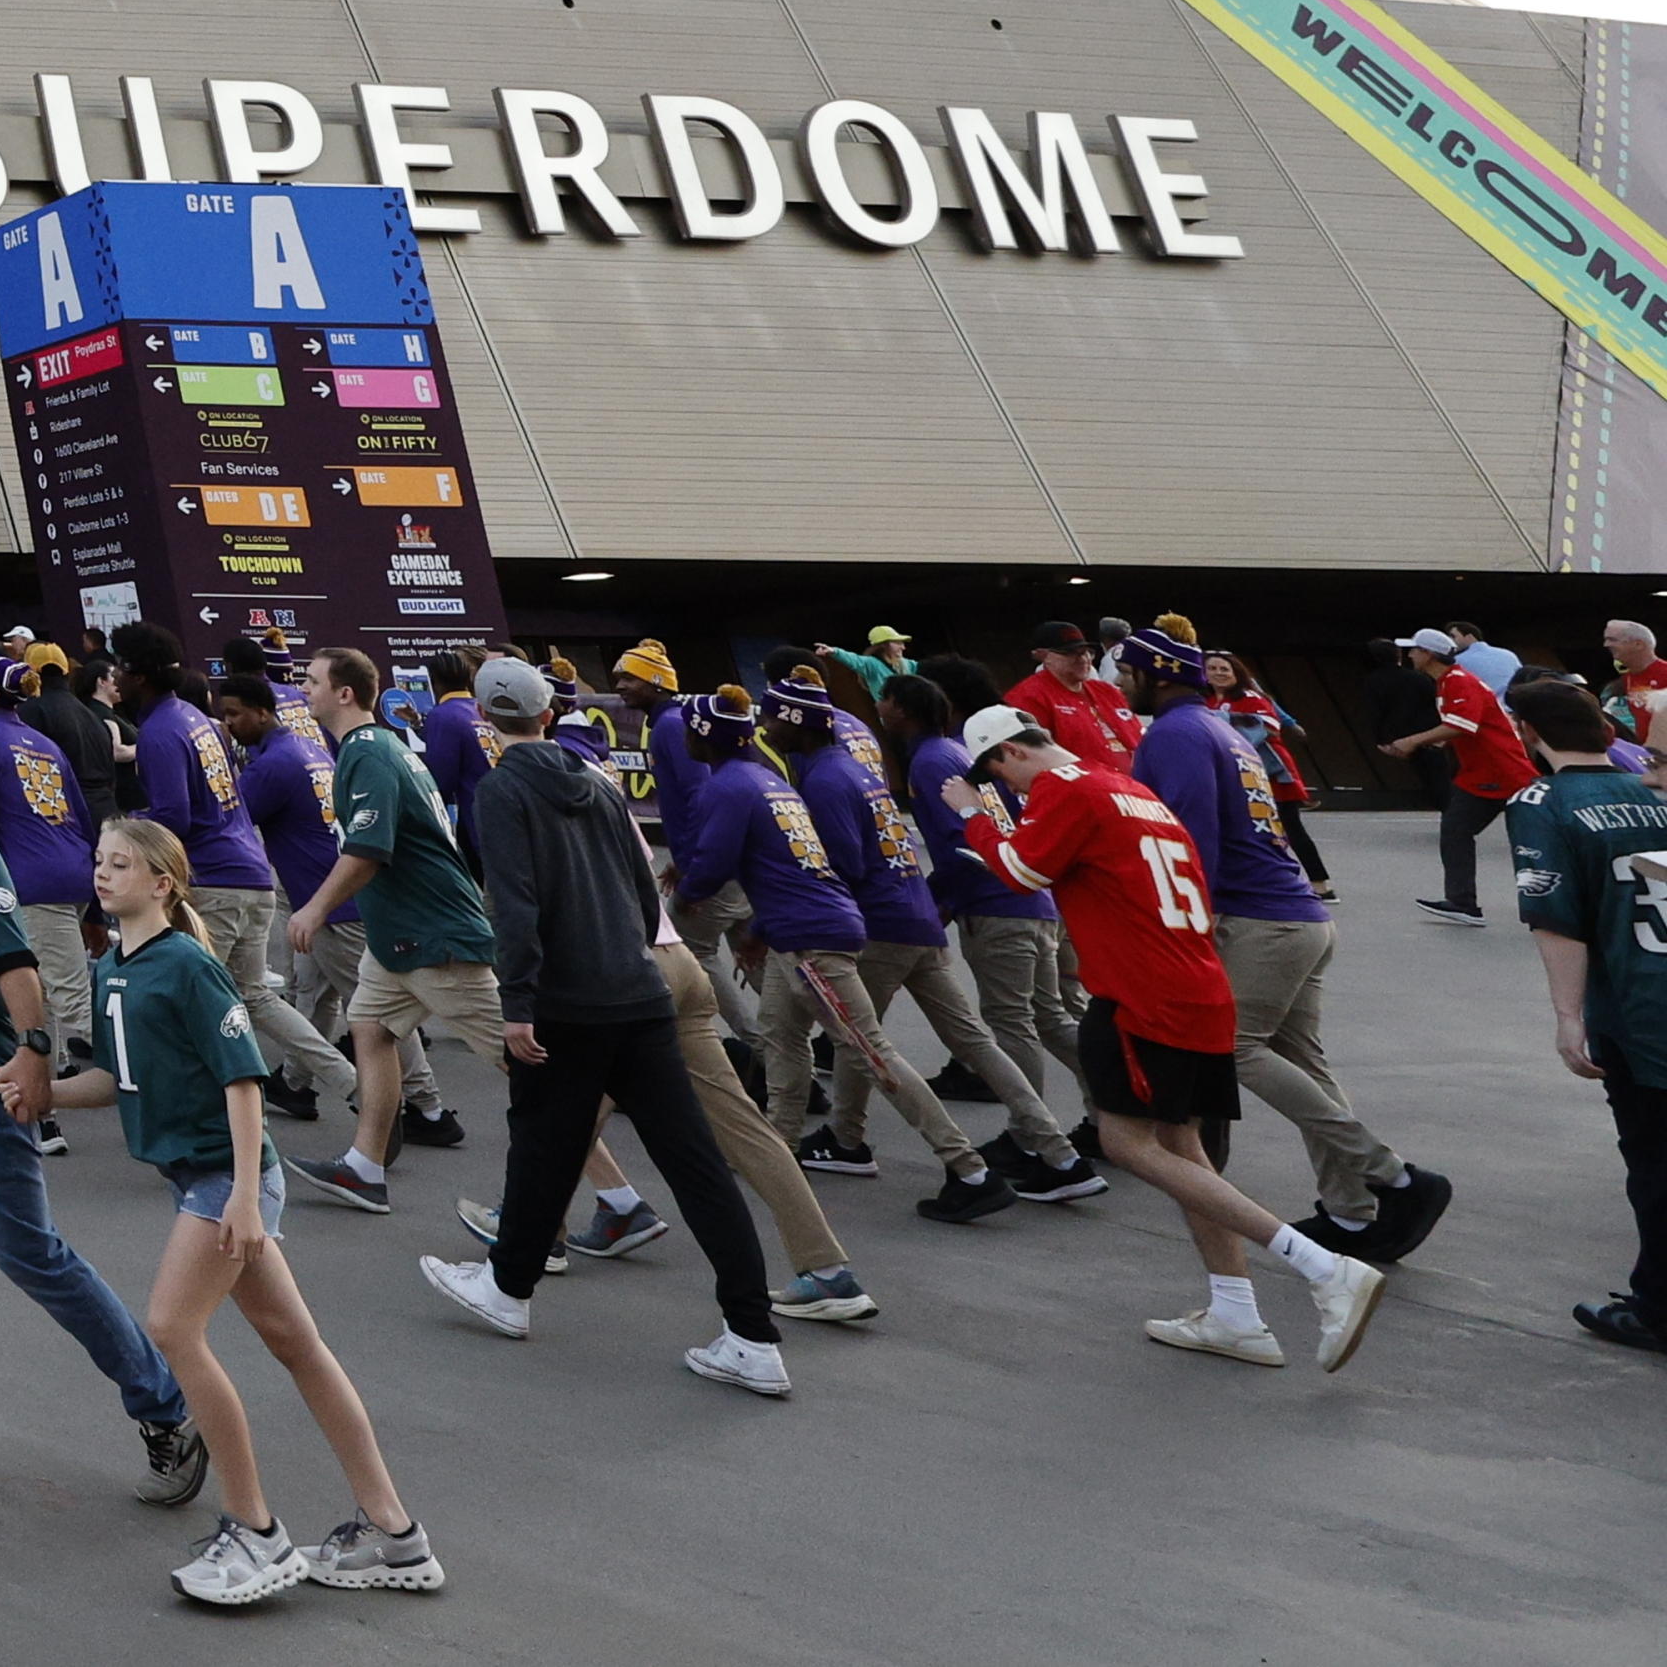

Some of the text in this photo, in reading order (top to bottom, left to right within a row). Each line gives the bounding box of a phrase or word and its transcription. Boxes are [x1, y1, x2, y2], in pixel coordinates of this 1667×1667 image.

[1291, 3, 1667, 339] WELCOME
[186, 193, 326, 310] GATE A
[3, 211, 83, 331] GATE A
[174, 330, 267, 361] GATE B
[330, 334, 424, 362] GATE H
[38, 335, 116, 382] EXIT Poydras St
[76, 385, 98, 400] Family
[98, 380, 110, 394] Lot
[182, 371, 274, 401] GATE C
[339, 374, 432, 403] GATE G
[49, 417, 82, 432] Rideshare
[222, 413, 260, 421] LOCATION
[385, 415, 423, 423] LOCATION
[106, 434, 118, 445] Ave
[357, 436, 382, 449] ON
[392, 436, 437, 450] FIFTY
[59, 471, 73, 483] 217
[200, 461, 280, 476] Fan Services
[360, 472, 451, 502] GATE F
[205, 491, 300, 522] GATES D E
[248, 535, 287, 544] LOCATION
[72, 545, 107, 561] Esplanade
[219, 556, 304, 574] TOUCHDOWN
[391, 555, 450, 570] GAMEDAY
[251, 576, 277, 585] CLUB
[387, 570, 464, 585] EXPERIENCE
[401, 601, 461, 611] BUD LIGHT
[387, 637, 486, 648] Enter stadium gates that
[391, 649, 417, 657] match
[418, 650, 440, 658] your
[777, 704, 803, 725] 26
[691, 713, 712, 736] 33
[1139, 835, 1210, 934] 15
[106, 992, 139, 1092] 1
